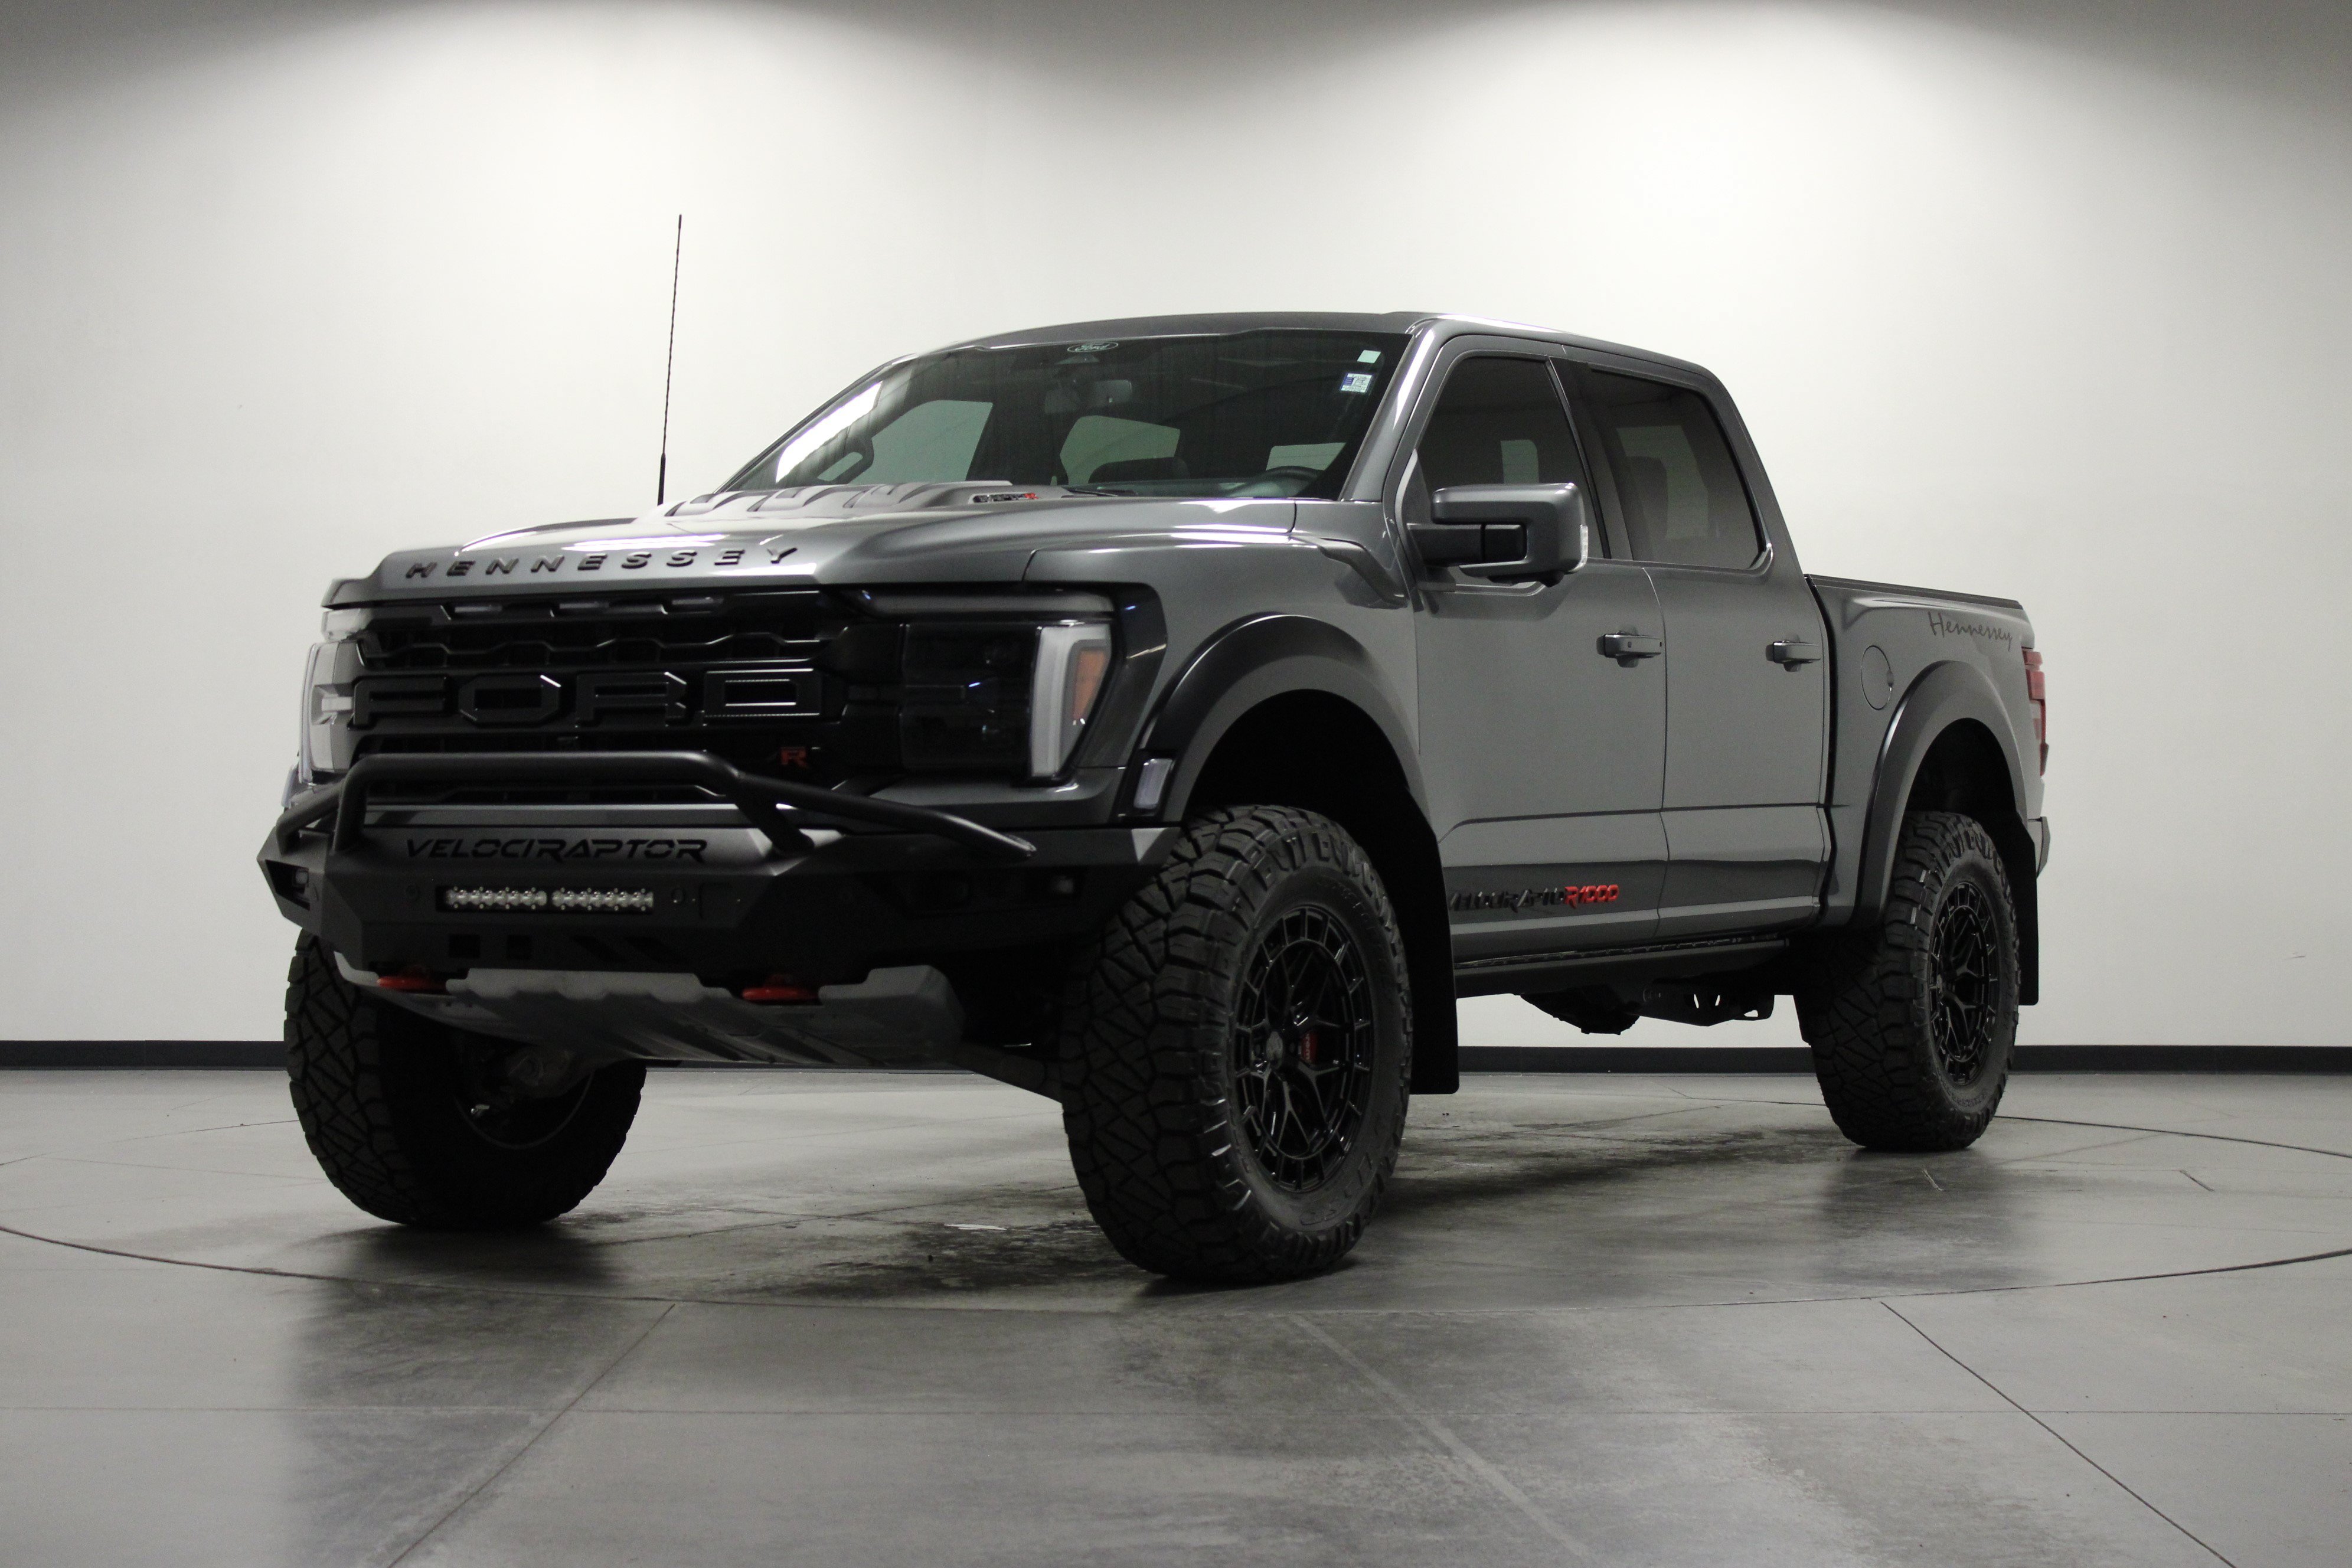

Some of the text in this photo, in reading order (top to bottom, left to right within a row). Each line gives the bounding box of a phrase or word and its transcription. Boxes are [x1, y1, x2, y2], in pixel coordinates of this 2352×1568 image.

[406, 545, 798, 579] HENNESSEY
[1928, 611, 2013, 651] Hennessey
[348, 668, 822, 727] FORD
[780, 746, 808, 769] R
[406, 838, 708, 863] VELOCIRAPTOR
